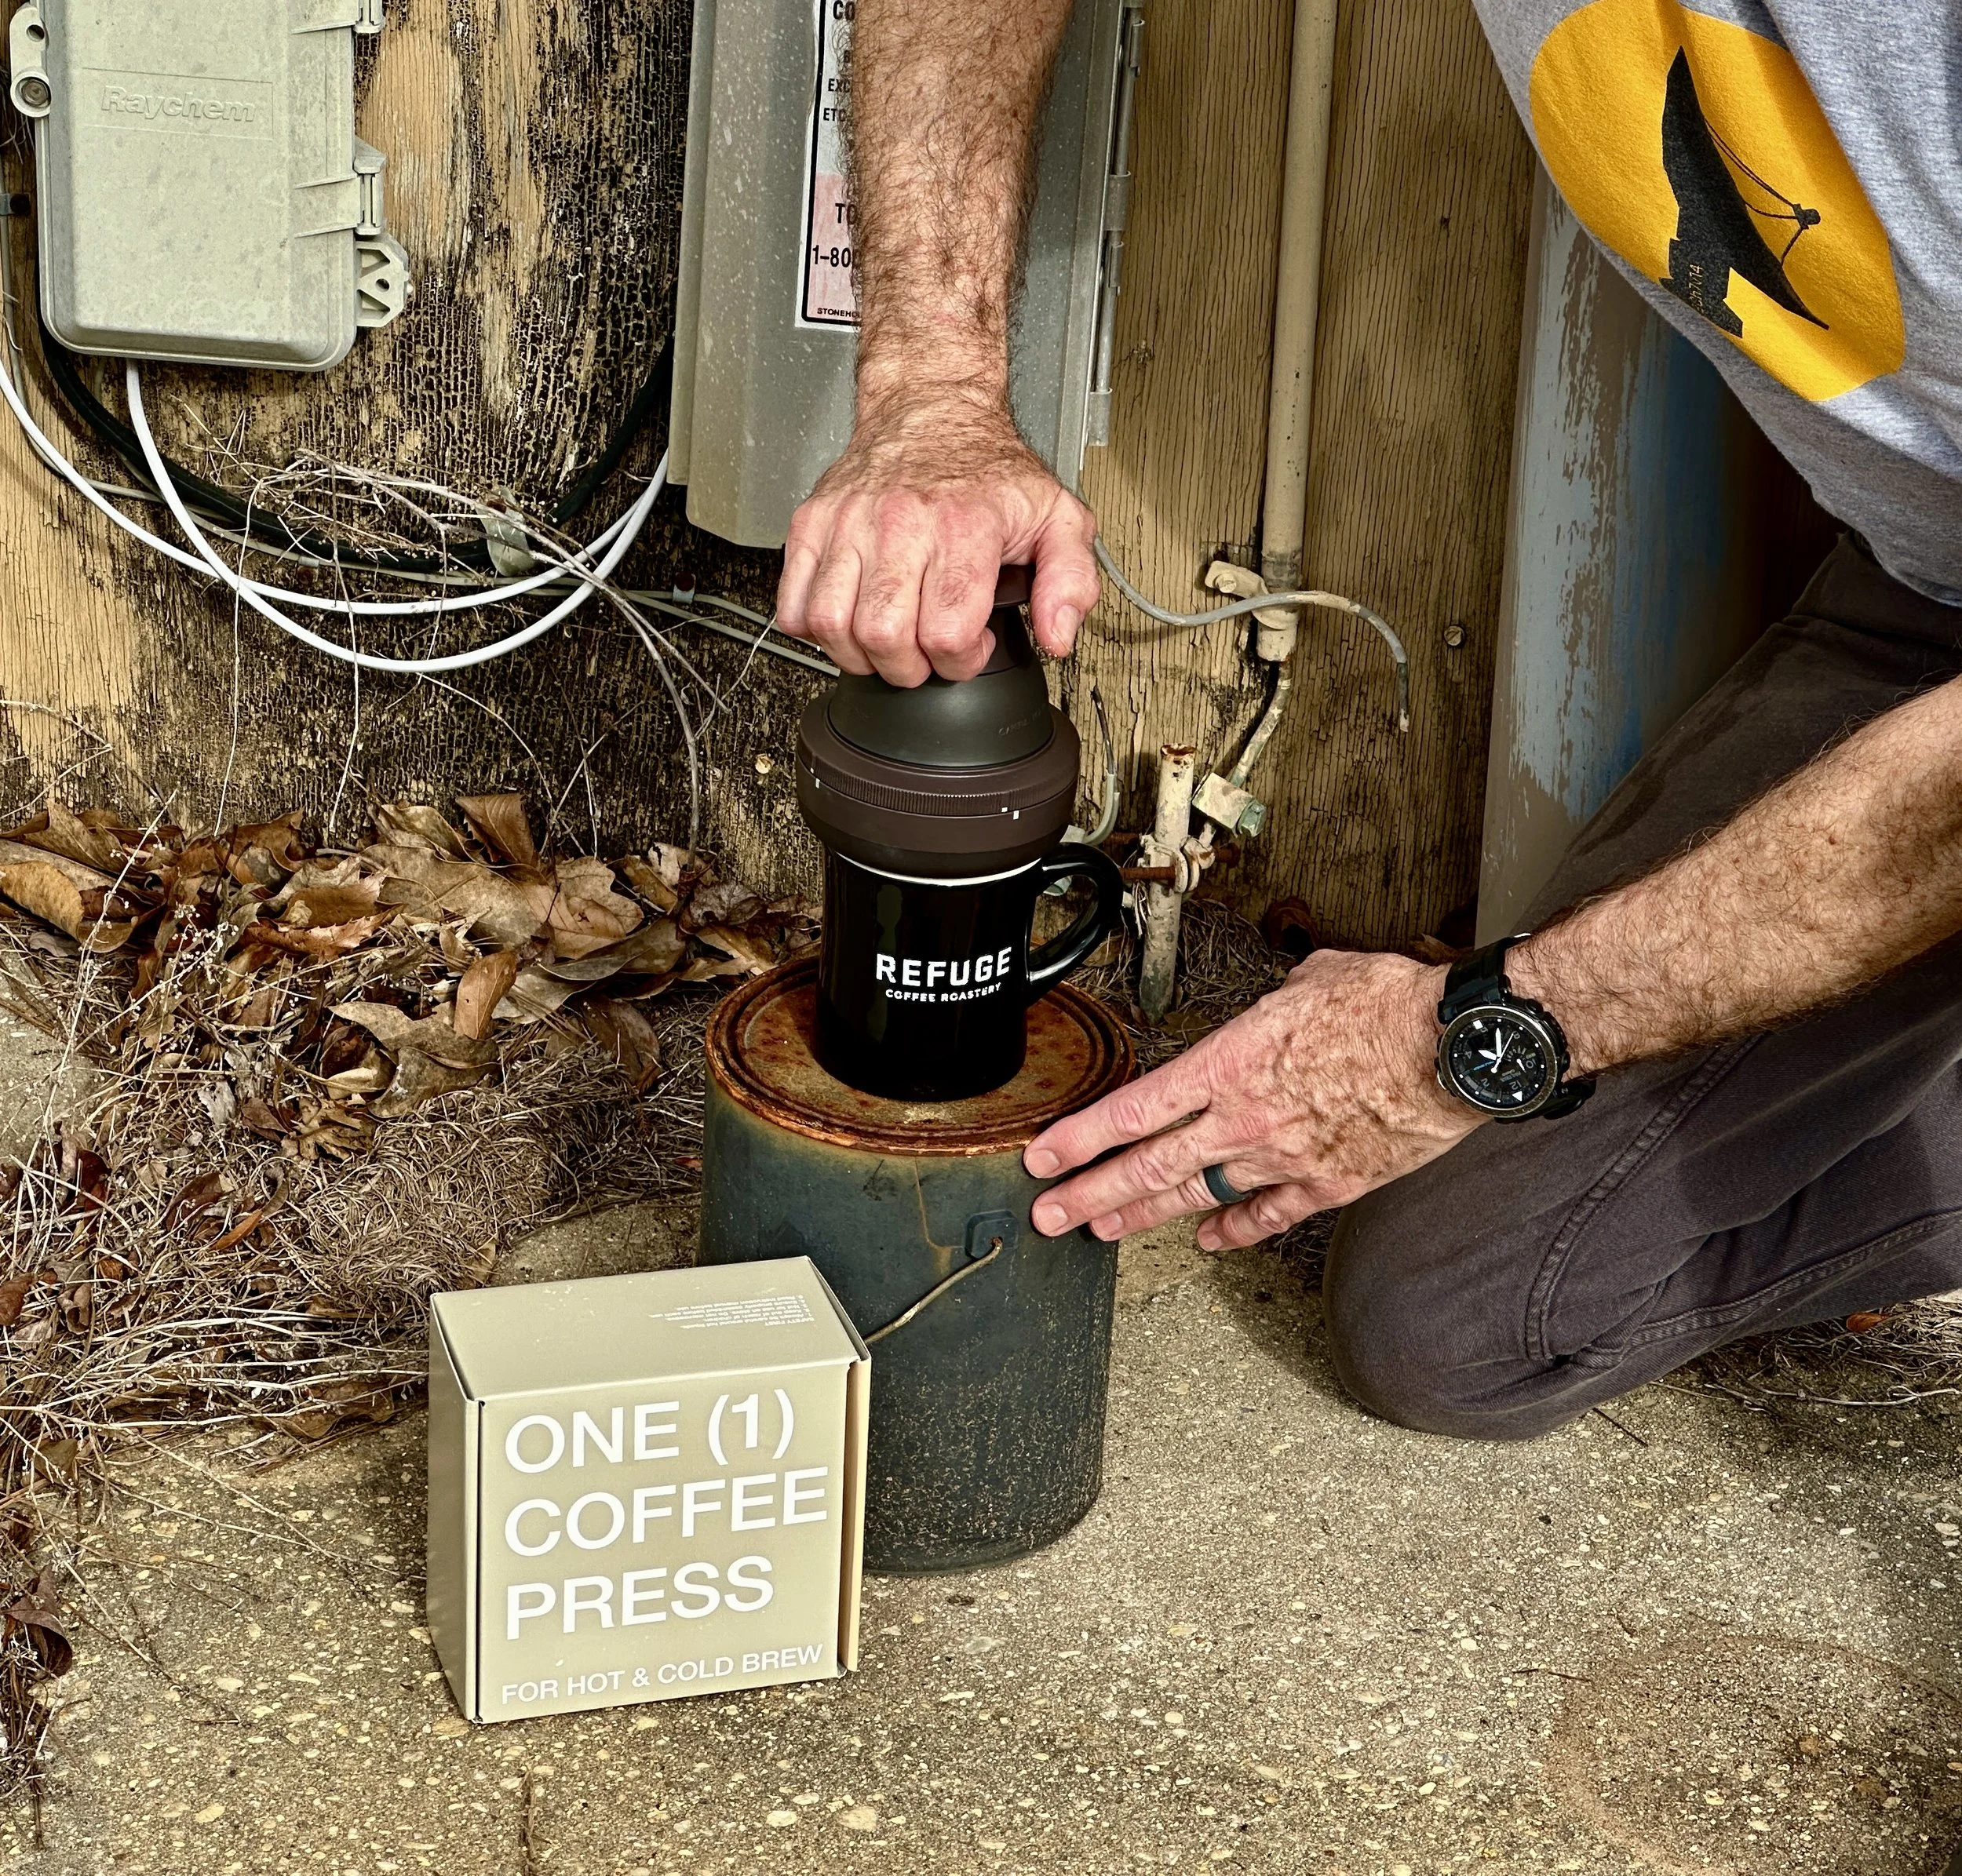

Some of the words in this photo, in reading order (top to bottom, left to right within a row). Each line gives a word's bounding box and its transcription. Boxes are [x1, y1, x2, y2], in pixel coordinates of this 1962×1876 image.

[100, 84, 256, 122] Raychem
[828, 78, 853, 93] EXC
[876, 946, 1012, 987] REFUGE
[885, 989, 936, 1002] COFFEE
[941, 982, 1001, 1002] ROASTERY
[505, 1401, 680, 1473] ONE
[707, 1388, 795, 1466] (1)
[505, 1466, 829, 1557] COFFEE
[506, 1555, 775, 1641] PRESS
[501, 1679, 559, 1705] FOR
[567, 1670, 625, 1697] HOT
[633, 1667, 651, 1688] &
[657, 1656, 734, 1682] COLD
[742, 1644, 823, 1673] BREW
